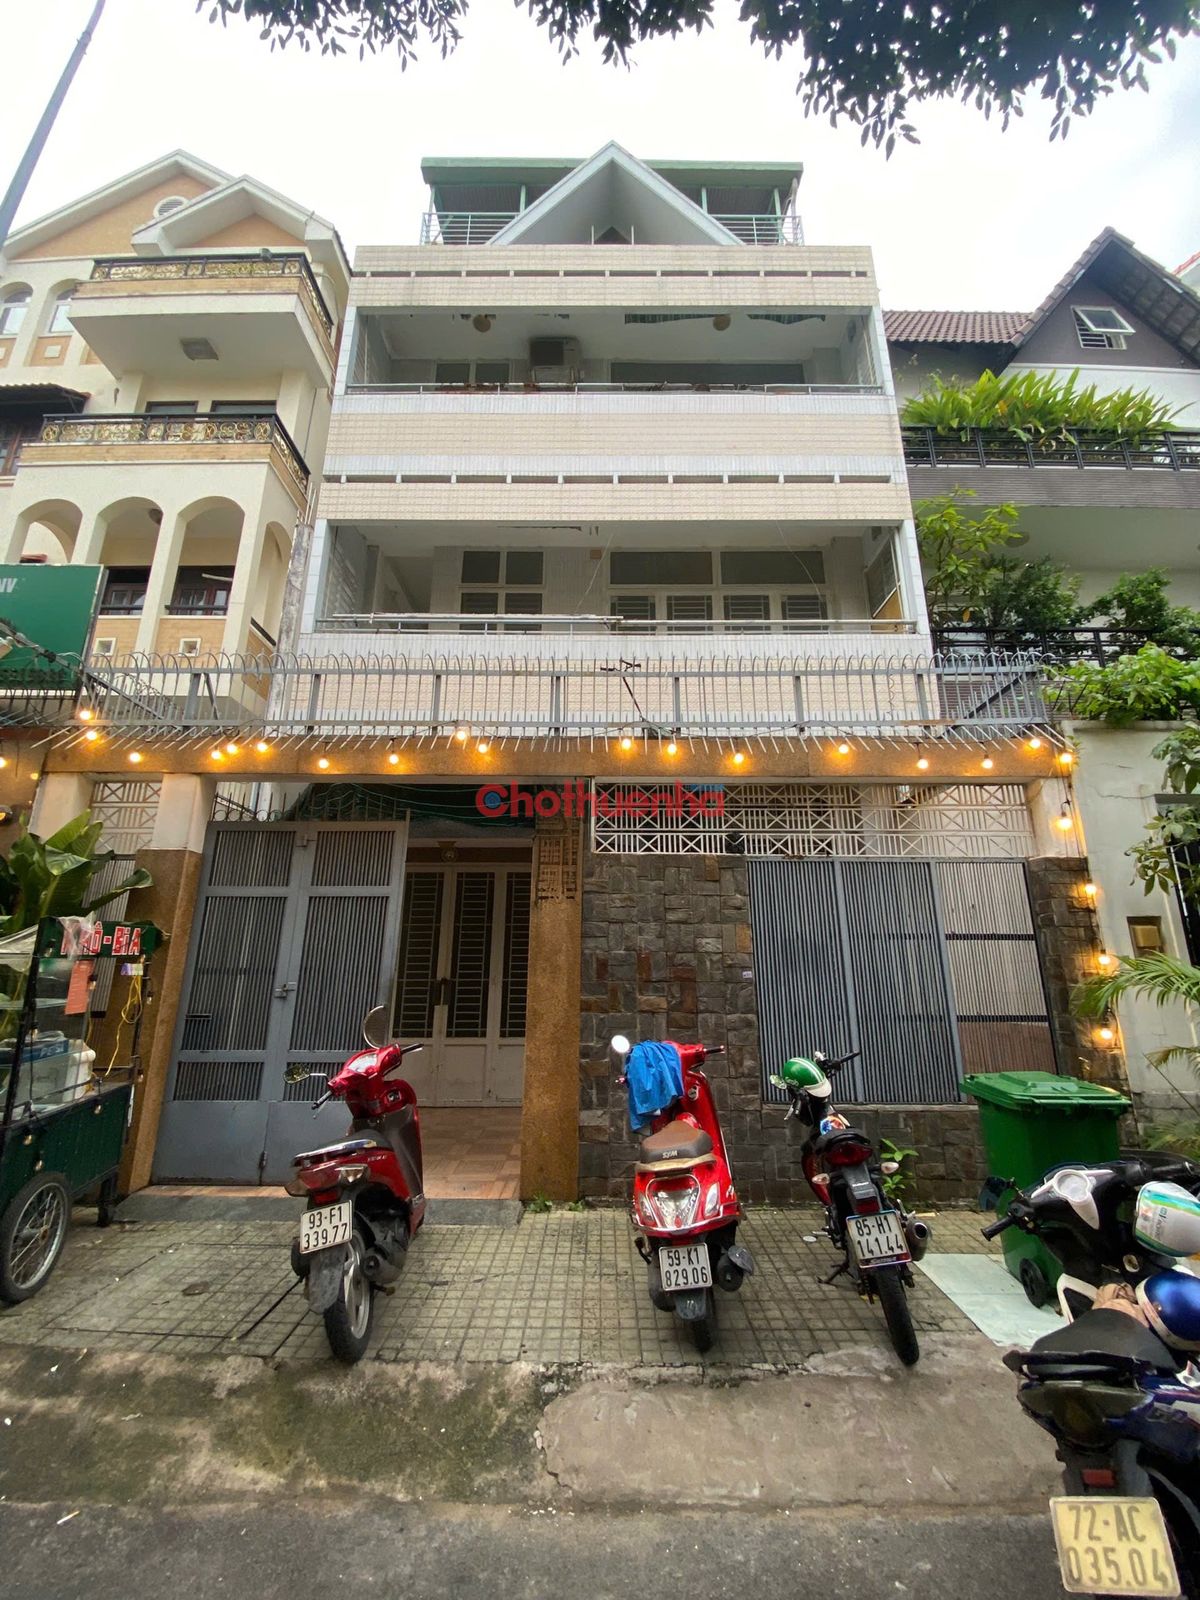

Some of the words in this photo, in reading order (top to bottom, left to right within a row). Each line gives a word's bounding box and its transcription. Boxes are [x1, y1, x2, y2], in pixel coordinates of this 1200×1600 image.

[662, 1149, 678, 1159] SYM
[309, 1205, 343, 1230] 93-F1
[855, 1214, 893, 1237] 85-H1
[303, 1222, 348, 1250] 339.77
[856, 1233, 904, 1258] 141.44
[666, 1247, 700, 1268] 59-K1
[664, 1265, 708, 1288] 829.06
[1067, 1504, 1147, 1543] 72-AC
[1064, 1545, 1170, 1588] 035.04
